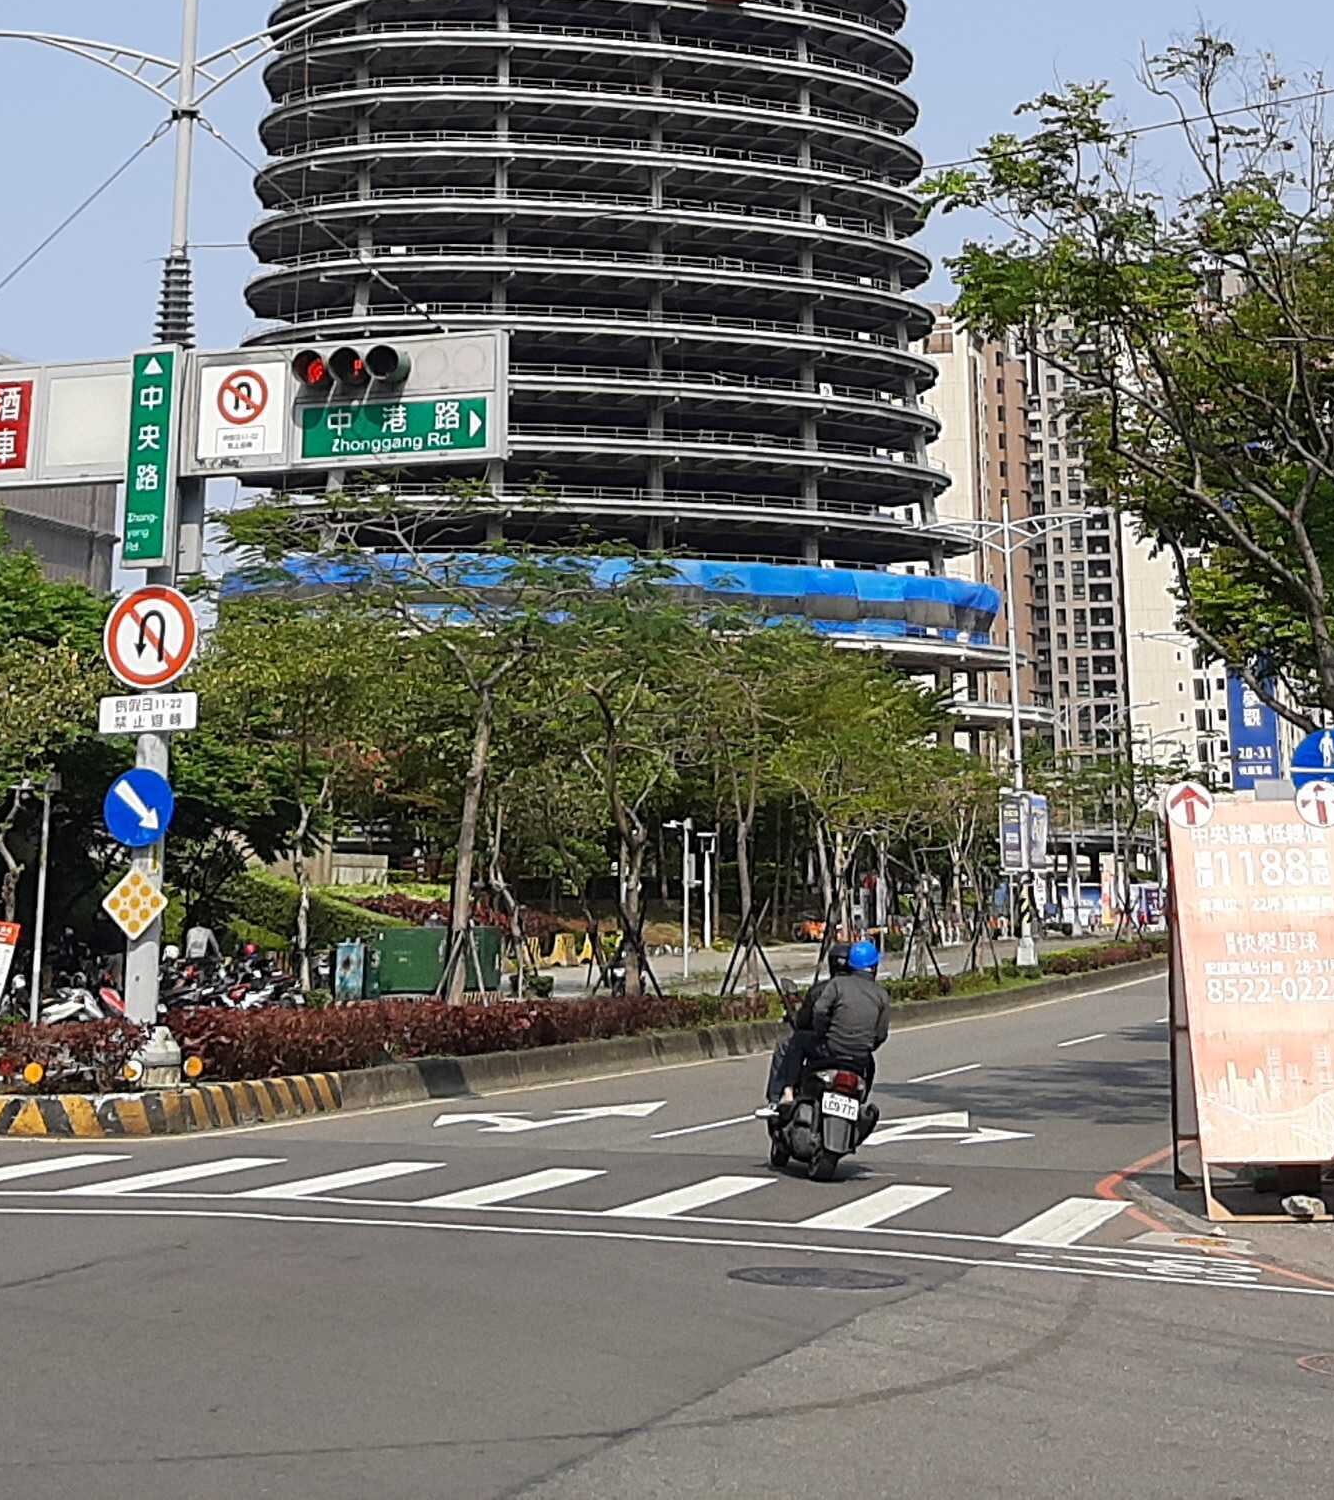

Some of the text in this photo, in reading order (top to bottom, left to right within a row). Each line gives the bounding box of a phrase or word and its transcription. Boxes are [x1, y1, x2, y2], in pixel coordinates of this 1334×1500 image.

[327, 401, 460, 436] 中港路
[135, 385, 164, 491] 中央路
[331, 432, 454, 452] Zhonggang Rd.
